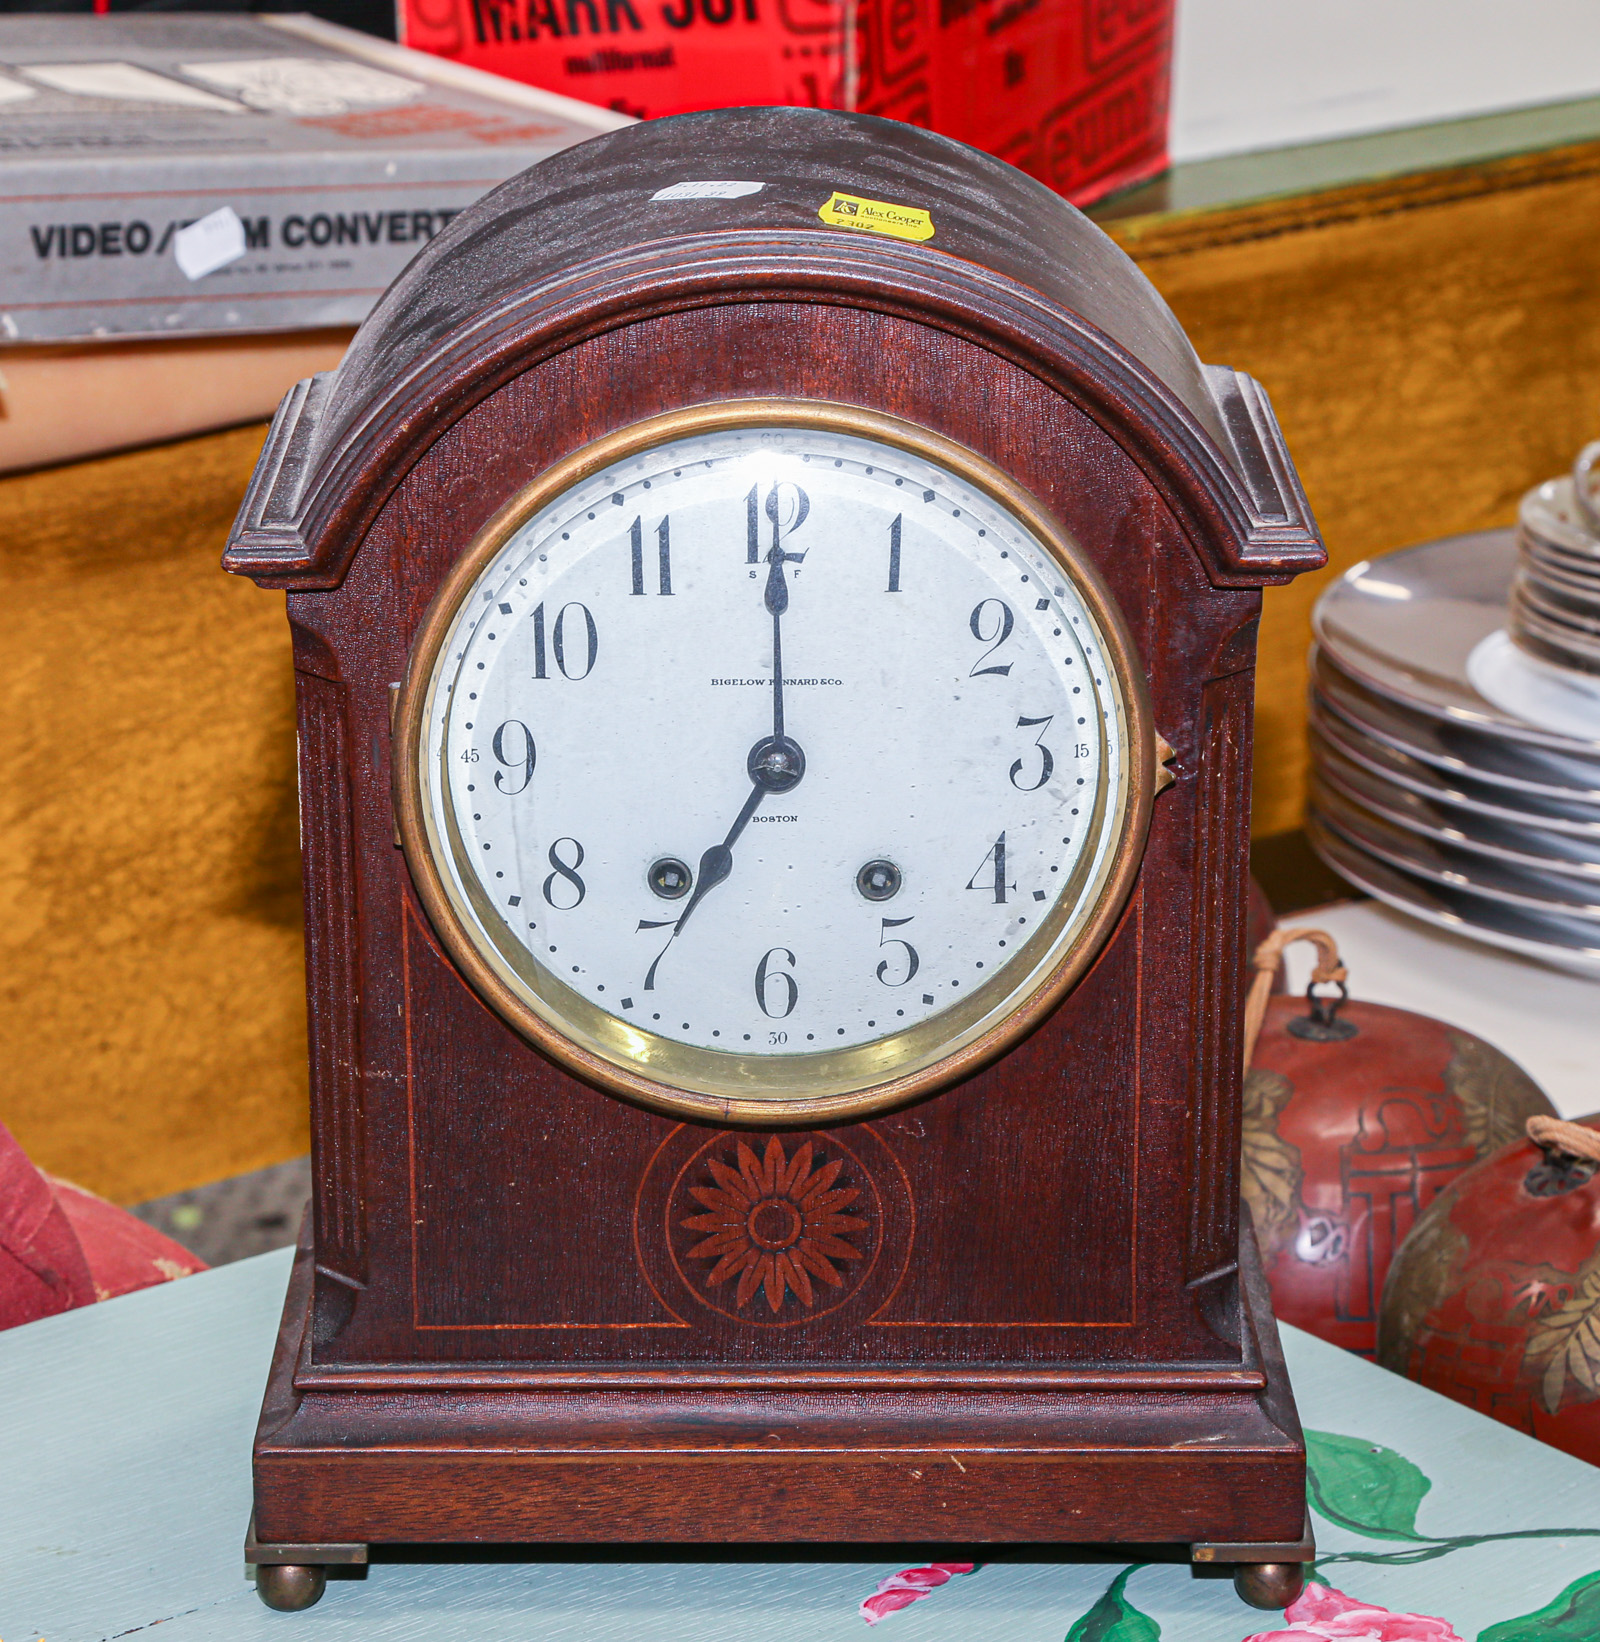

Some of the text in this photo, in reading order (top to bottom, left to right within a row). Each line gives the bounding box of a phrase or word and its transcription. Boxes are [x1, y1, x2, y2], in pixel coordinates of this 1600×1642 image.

[862, 207, 924, 225] Alex Cooper
[627, 514, 676, 596] 11
[743, 482, 810, 564] 12
[884, 512, 903, 592] 1
[749, 570, 757, 579] S
[794, 570, 801, 578] F
[529, 601, 598, 681] 10
[969, 598, 1014, 678] 2
[711, 678, 765, 686] BIGELOW
[460, 748, 480, 763] 45
[492, 719, 537, 795] 9
[1009, 714, 1055, 791] 3
[1074, 743, 1090, 758] 15
[752, 815, 798, 823] BOSTON
[542, 837, 586, 910] 8
[965, 830, 1017, 904] 4
[635, 919, 680, 990] 7
[754, 947, 798, 1019] 6
[876, 916, 919, 987] 5
[767, 1031, 788, 1045] 30
